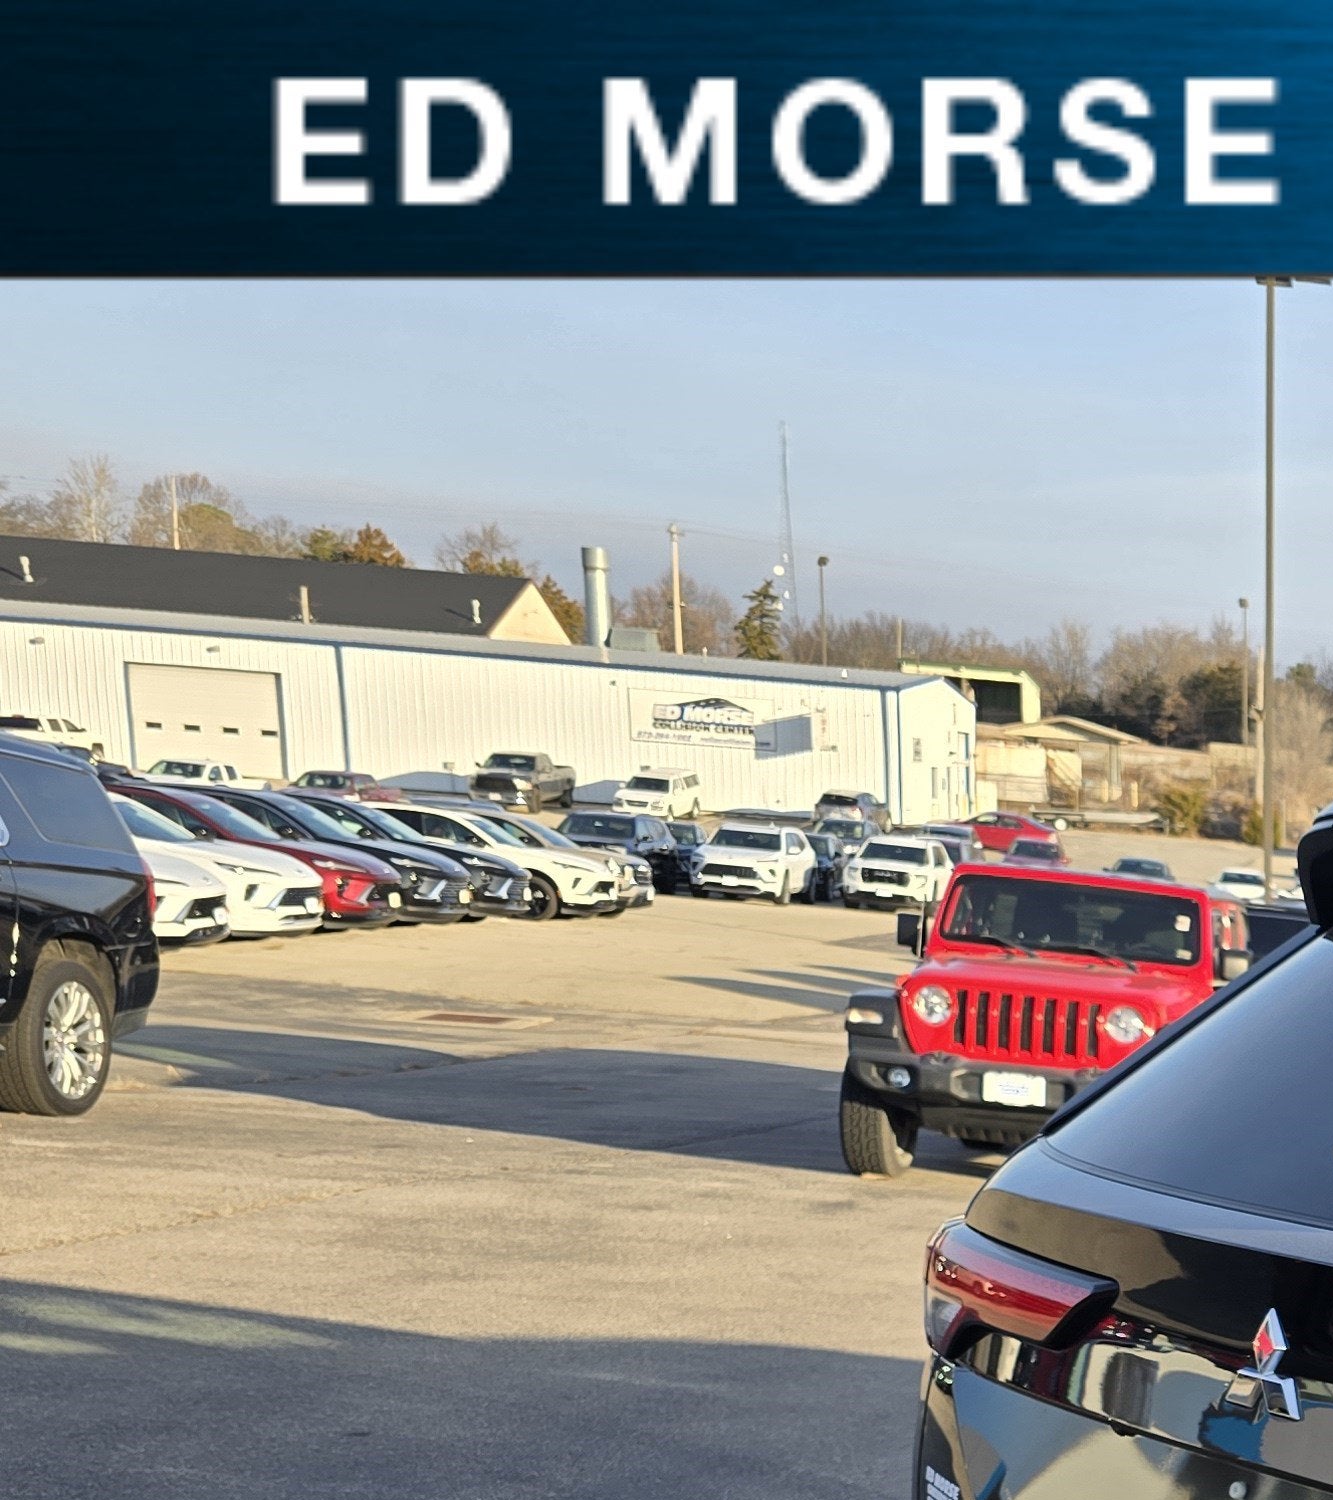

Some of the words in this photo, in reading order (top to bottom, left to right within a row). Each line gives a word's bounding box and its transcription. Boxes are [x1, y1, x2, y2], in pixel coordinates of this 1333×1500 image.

[653, 704, 682, 720] ED
[682, 705, 754, 727] MORSE
[652, 720, 711, 733] COLLISION
[714, 724, 754, 736] CENTER
